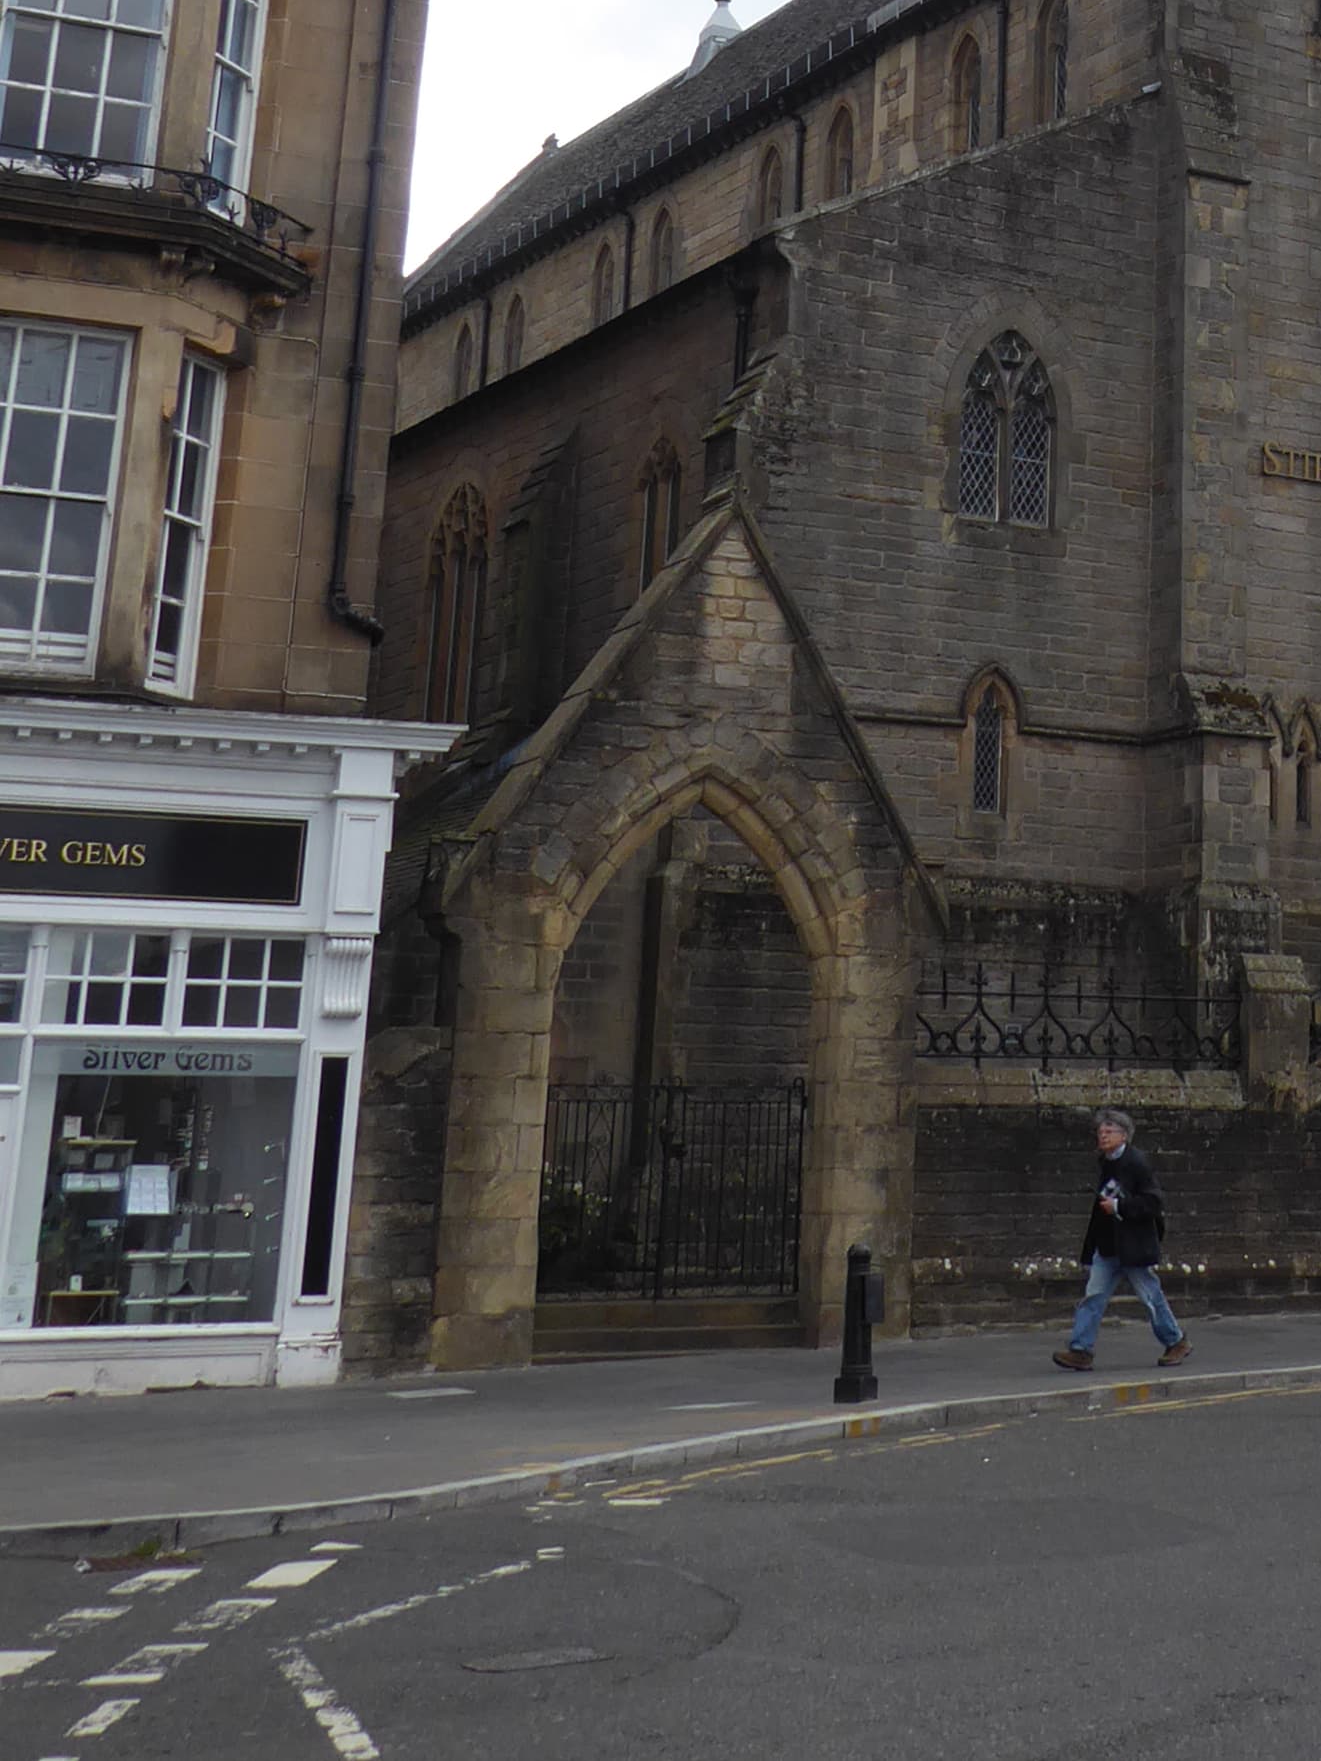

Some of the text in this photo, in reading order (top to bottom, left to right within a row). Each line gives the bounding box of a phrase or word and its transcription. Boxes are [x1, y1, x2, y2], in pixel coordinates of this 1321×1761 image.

[61, 840, 147, 867] GEMS
[82, 1042, 253, 1072] Silver Gems
